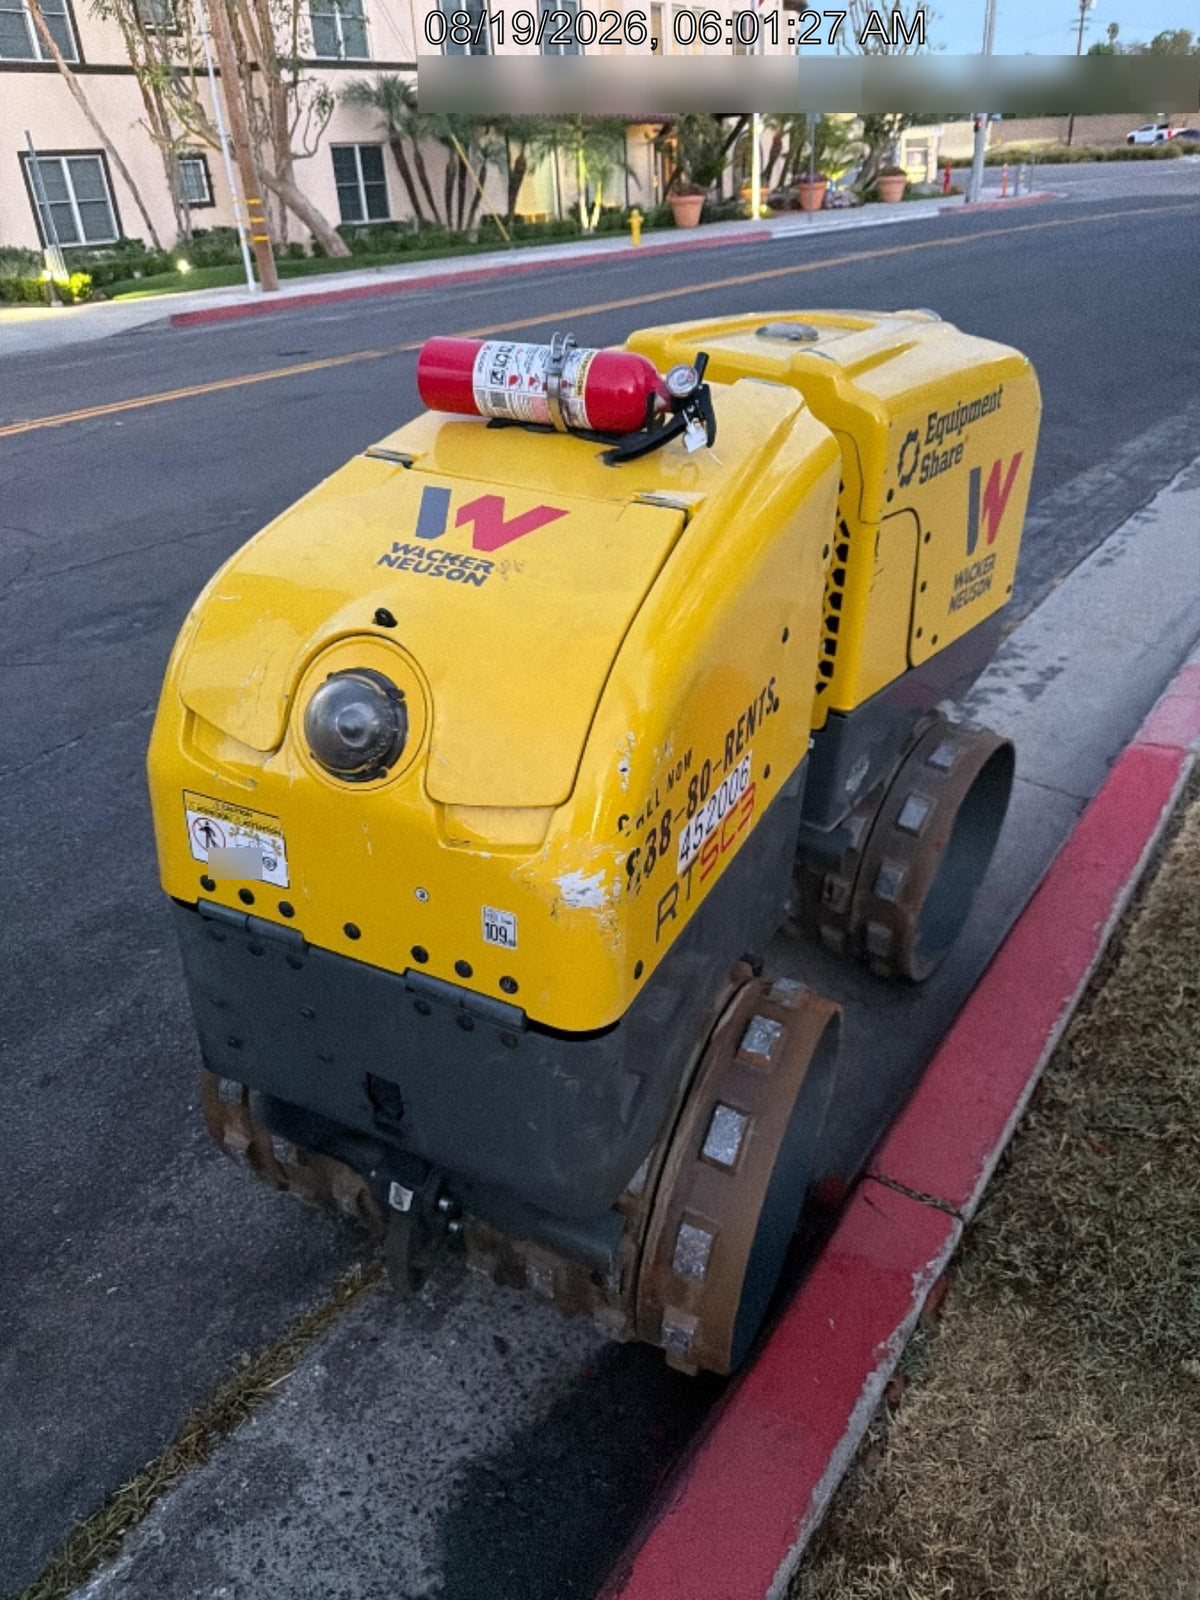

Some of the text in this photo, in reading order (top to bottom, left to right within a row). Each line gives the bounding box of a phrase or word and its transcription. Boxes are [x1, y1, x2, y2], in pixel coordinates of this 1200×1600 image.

[925, 384, 1004, 446] Equipment
[919, 441, 964, 485] Share
[377, 554, 488, 587] NEUSON
[392, 541, 495, 575] WACKER
[954, 553, 997, 590] WACKER
[949, 575, 993, 616] NEUSON
[667, 747, 693, 794] NOW
[679, 754, 750, 863] 452006
[485, 922, 508, 945] 109
